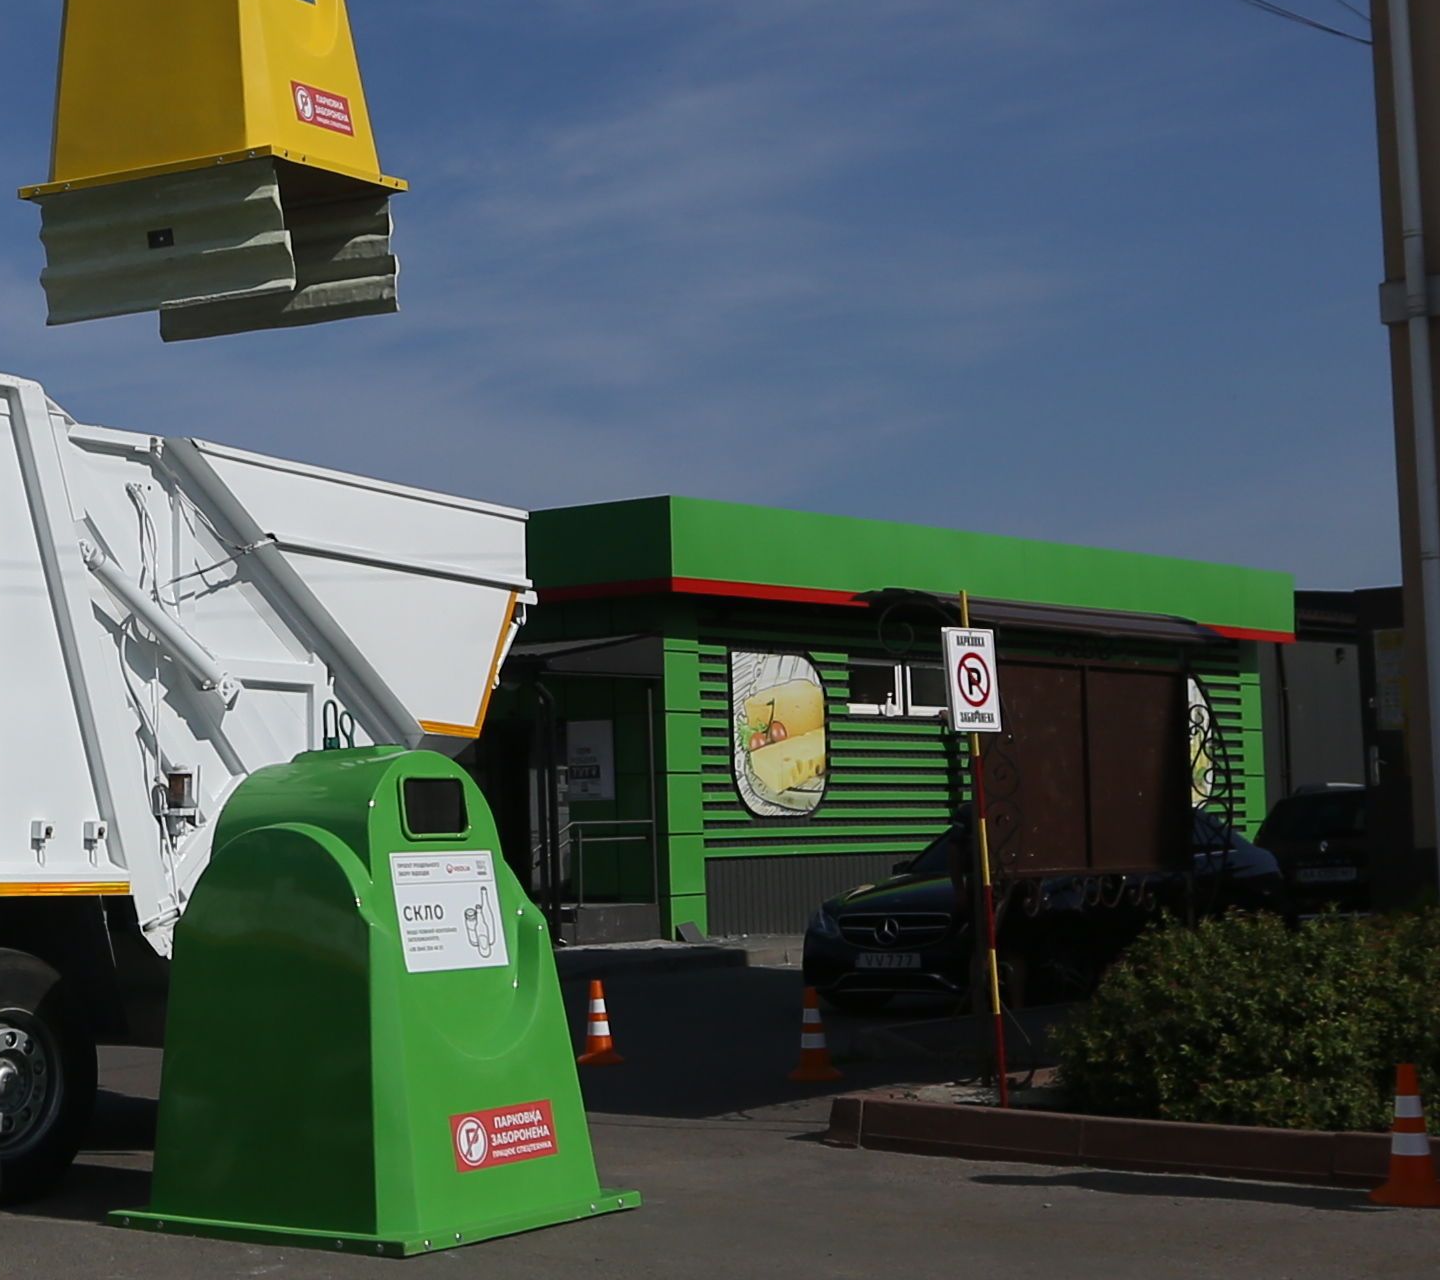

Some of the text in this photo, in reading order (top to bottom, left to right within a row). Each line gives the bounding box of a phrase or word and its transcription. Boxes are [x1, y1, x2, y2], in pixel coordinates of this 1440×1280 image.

[403, 904, 444, 922] СКЛО
[494, 1109, 542, 1129] ПАРКОВКА
[490, 1124, 550, 1146] ЗАБОРОНЕНА
